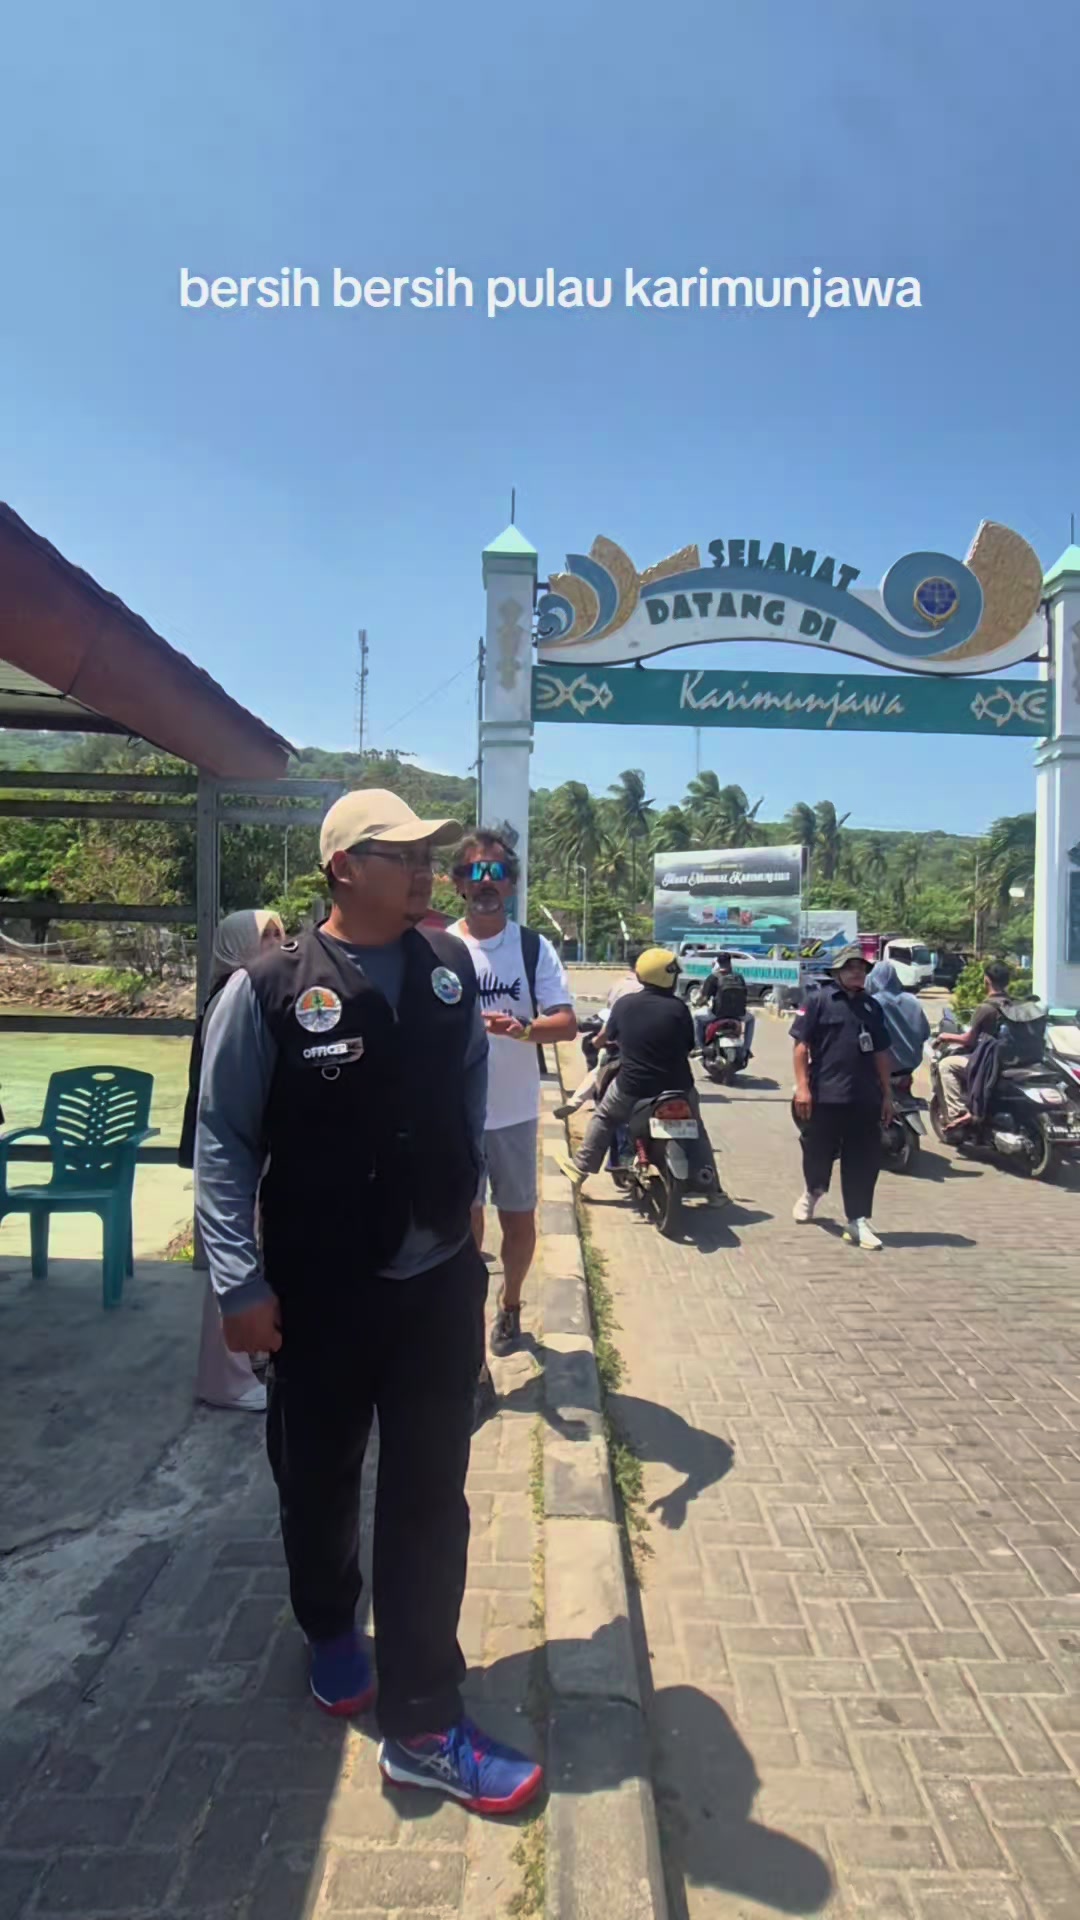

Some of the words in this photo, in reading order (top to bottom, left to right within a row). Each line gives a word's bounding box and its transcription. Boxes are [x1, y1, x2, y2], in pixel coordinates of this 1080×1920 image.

[708, 538, 860, 592] SELAMAT
[646, 592, 785, 626] DATANG
[798, 608, 838, 644] DI
[679, 669, 905, 729] Karimunjawa
